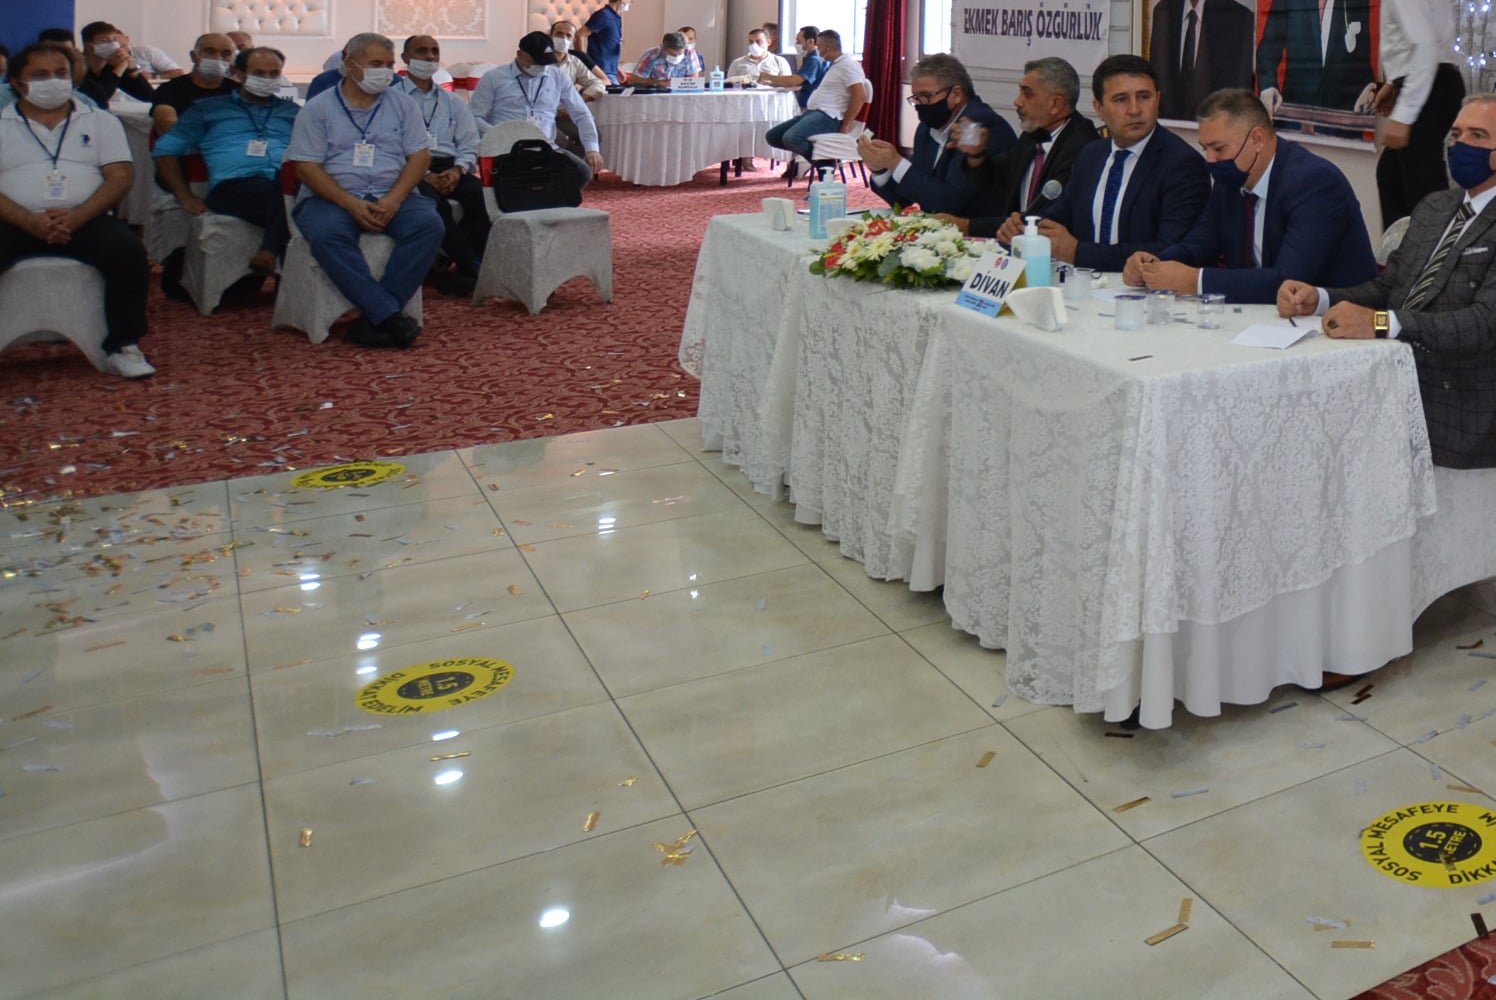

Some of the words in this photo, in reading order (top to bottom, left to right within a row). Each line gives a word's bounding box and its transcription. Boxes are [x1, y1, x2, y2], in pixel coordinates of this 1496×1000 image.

[963, 8, 999, 36] EKMEK
[1001, 9, 1033, 47] BARIŞ
[1036, 2, 1103, 41] ÖZGÜRLÜK
[969, 270, 1011, 299] DİVAN
[1368, 804, 1459, 839] MESAFEYE
[1419, 829, 1447, 849] 1.5
[1443, 830, 1468, 855] ETRE
[1367, 841, 1422, 881] SOSYAL
